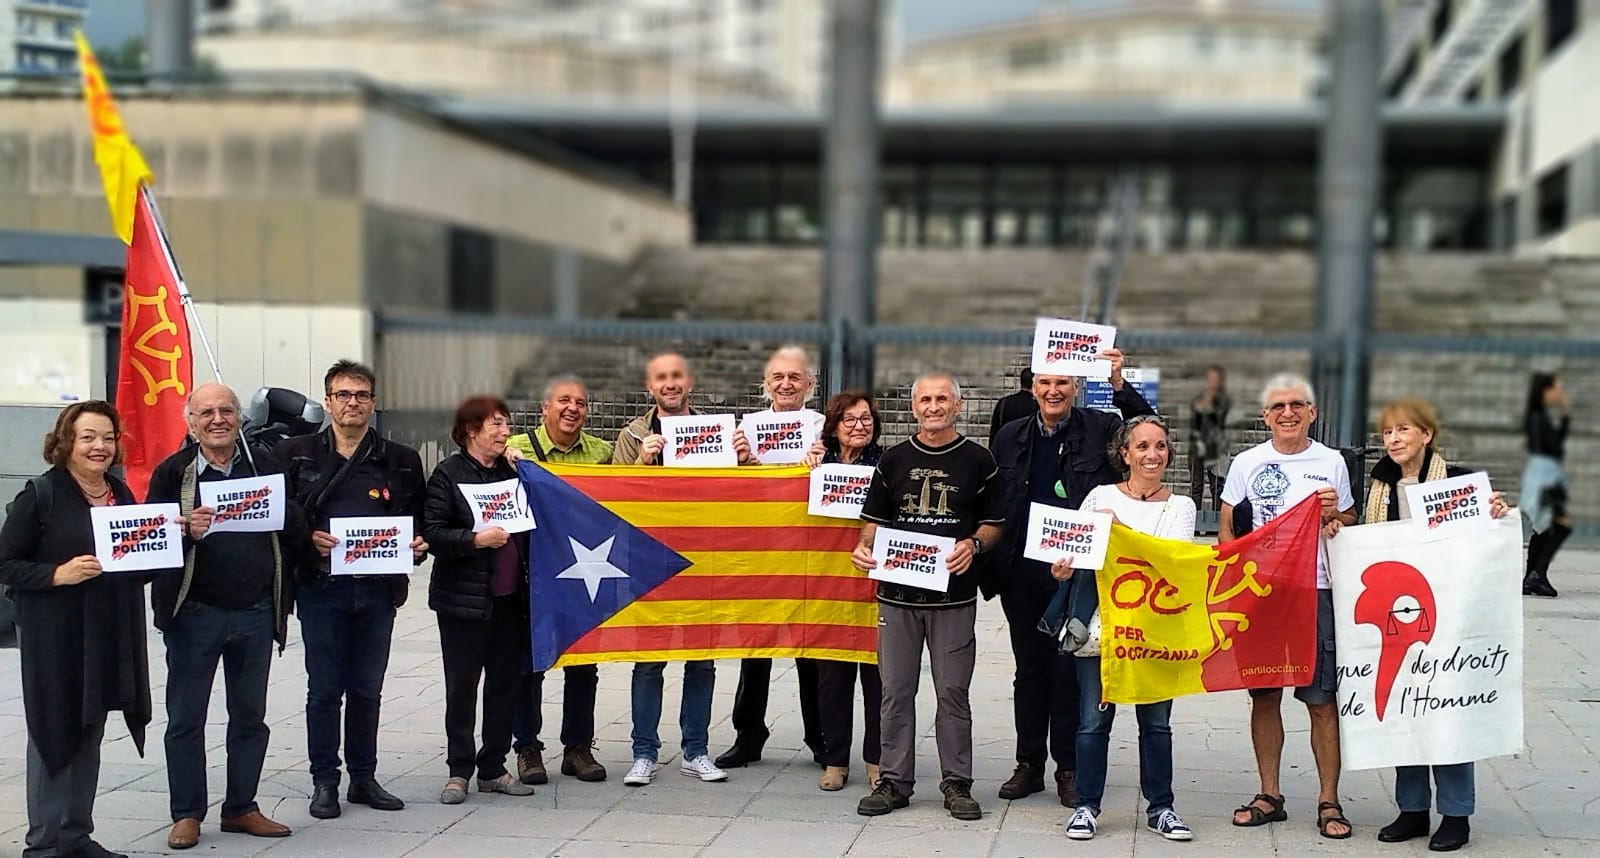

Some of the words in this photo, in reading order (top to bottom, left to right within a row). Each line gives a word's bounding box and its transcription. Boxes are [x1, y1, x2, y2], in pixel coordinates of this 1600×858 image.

[1049, 330, 1099, 344] LLIBERTAT
[1047, 340, 1097, 354] PRESOS
[675, 424, 722, 435] LLIBERTAT
[756, 421, 802, 432] LLIBERTAT
[676, 434, 722, 446] PRESOS
[757, 431, 802, 443] PRESOS
[823, 474, 870, 485] LLIBERTAT
[217, 488, 270, 502] LLIBERTAT
[472, 490, 512, 500] LLIBERTAT
[823, 483, 870, 496] PRESOS
[1422, 485, 1476, 503] LLIBERTAT
[216, 499, 270, 514] PRESOS
[478, 501, 514, 511] PRESOS
[822, 494, 865, 505] POLÍTICS
[1426, 496, 1478, 515] PRESOS
[109, 516, 165, 530] LLIBERTAT
[1043, 517, 1095, 532] LLIBERTAT
[111, 528, 167, 543] PRESOS
[346, 527, 398, 537] LLIBERTAT
[1042, 527, 1092, 544] PRESOS
[346, 538, 398, 549] PRESOS
[888, 540, 939, 555] LLIBERTAT
[887, 549, 937, 565] PRESOS
[1114, 626, 1145, 642] PER
[1411, 649, 1438, 683] des
[1443, 644, 1510, 676] droits
[1341, 691, 1366, 717] de
[1400, 684, 1499, 718] l'Homme
